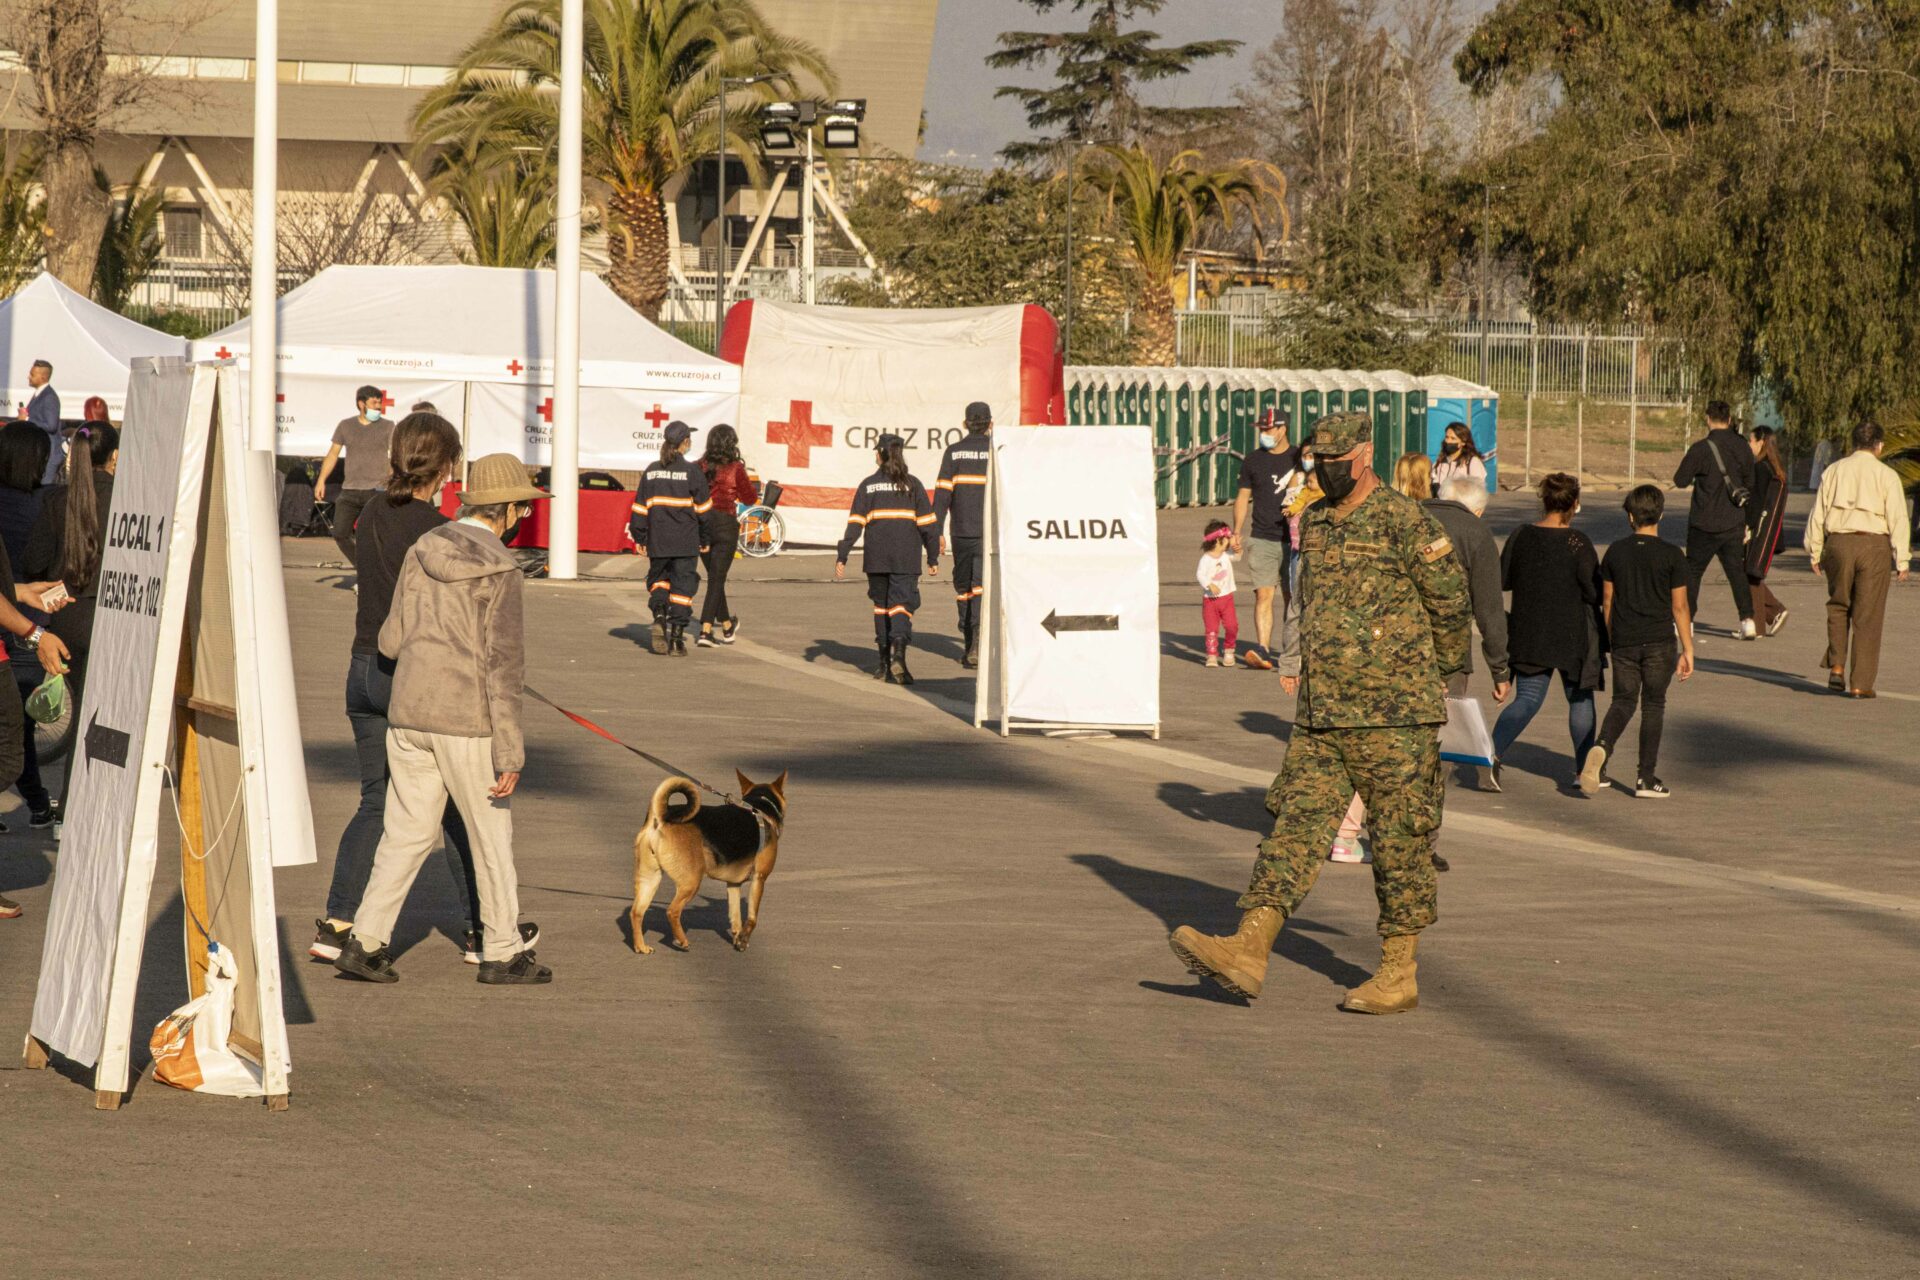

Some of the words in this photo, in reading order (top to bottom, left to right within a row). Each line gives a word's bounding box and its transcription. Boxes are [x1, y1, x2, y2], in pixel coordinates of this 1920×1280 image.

[357, 357, 434, 368] www.cruzroja.cl
[646, 369, 721, 380] www.cruzroja.cl
[524, 425, 547, 434] CRUZ
[528, 436, 553, 444] CHILE
[632, 431, 655, 440] CRUZ
[636, 442, 662, 450] CHILE
[951, 450, 979, 460] DEFENSA
[646, 470, 671, 480] DEFENSA
[671, 471, 688, 480] CIVIL
[109, 512, 151, 551] LOCAL
[157, 516, 165, 553] 1
[1026, 518, 1128, 540] SALIDA
[98, 569, 127, 610] MESAS
[125, 573, 138, 612] 85
[136, 585, 144, 614] a
[144, 576, 161, 617] 102
